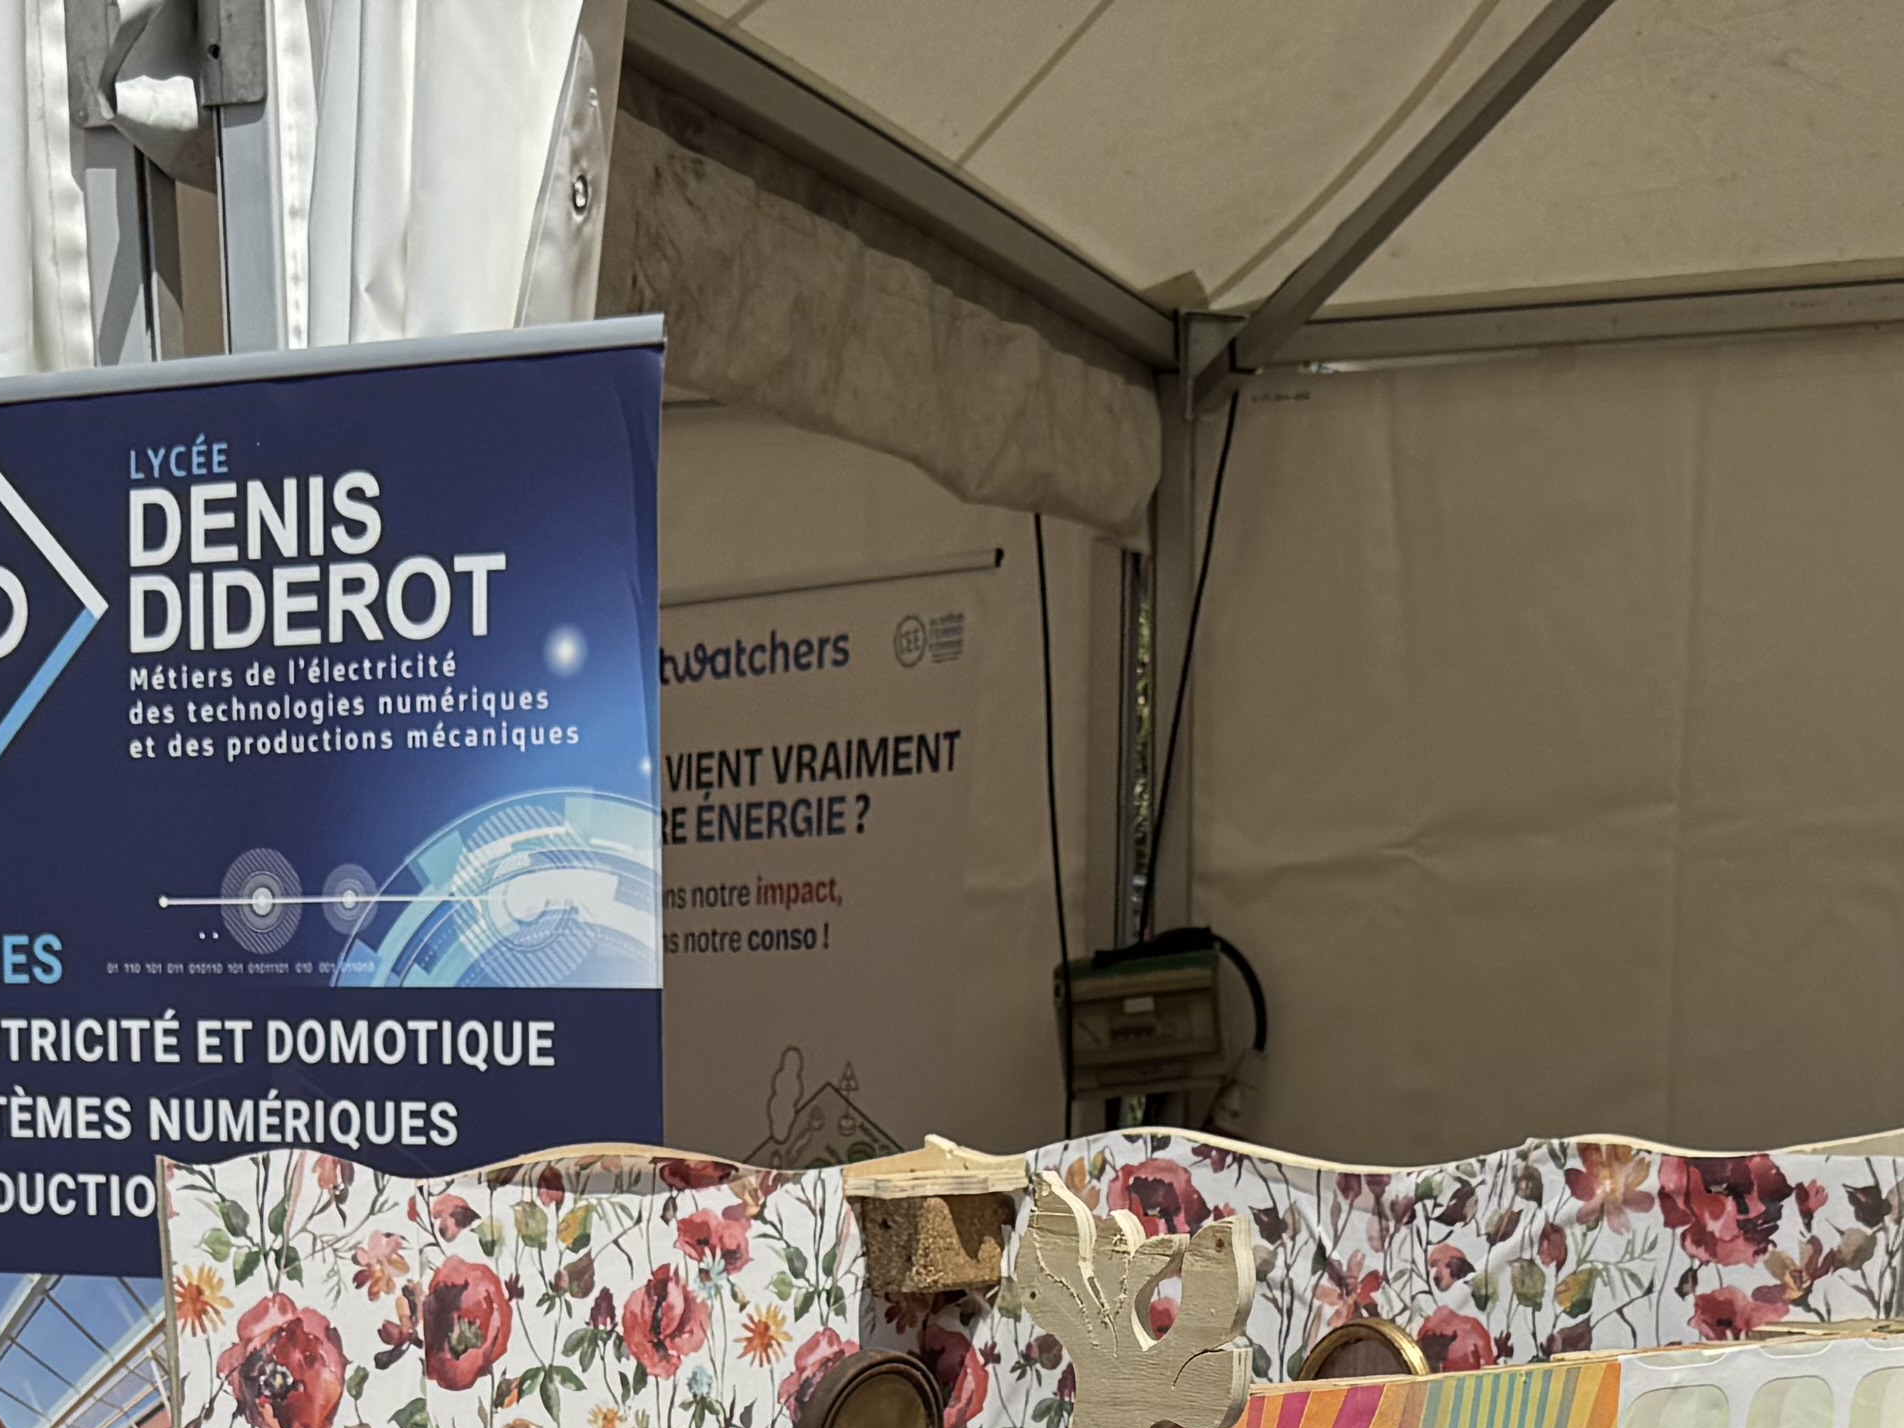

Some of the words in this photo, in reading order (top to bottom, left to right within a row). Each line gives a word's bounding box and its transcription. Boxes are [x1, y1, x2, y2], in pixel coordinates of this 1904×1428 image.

[129, 434, 228, 480] LYCÉE
[129, 470, 382, 567] DENIS
[129, 552, 507, 653] DIDEROT
[129, 664, 233, 691] Métiers
[246, 661, 276, 686] de
[289, 651, 457, 685] l'électricité
[129, 700, 175, 724] des
[188, 692, 365, 724] technologies
[378, 687, 549, 718] numériques
[129, 738, 156, 759] et
[168, 733, 214, 757] des
[227, 727, 393, 761] productions
[407, 722, 579, 752] mécaniques
[666, 747, 763, 792] VIENT
[772, 730, 961, 785] VRAIMENT
[696, 791, 847, 842] ÉNERGIE
[855, 793, 871, 834] ?
[691, 883, 752, 908] notre
[756, 876, 844, 910] impact,
[684, 928, 742, 954] notre
[748, 926, 818, 951] conso
[823, 921, 830, 949] !
[197, 1019, 253, 1064] ET
[267, 1018, 555, 1071] DOMOTIQUE
[149, 1089, 458, 1150] NUMÉRIQUES
